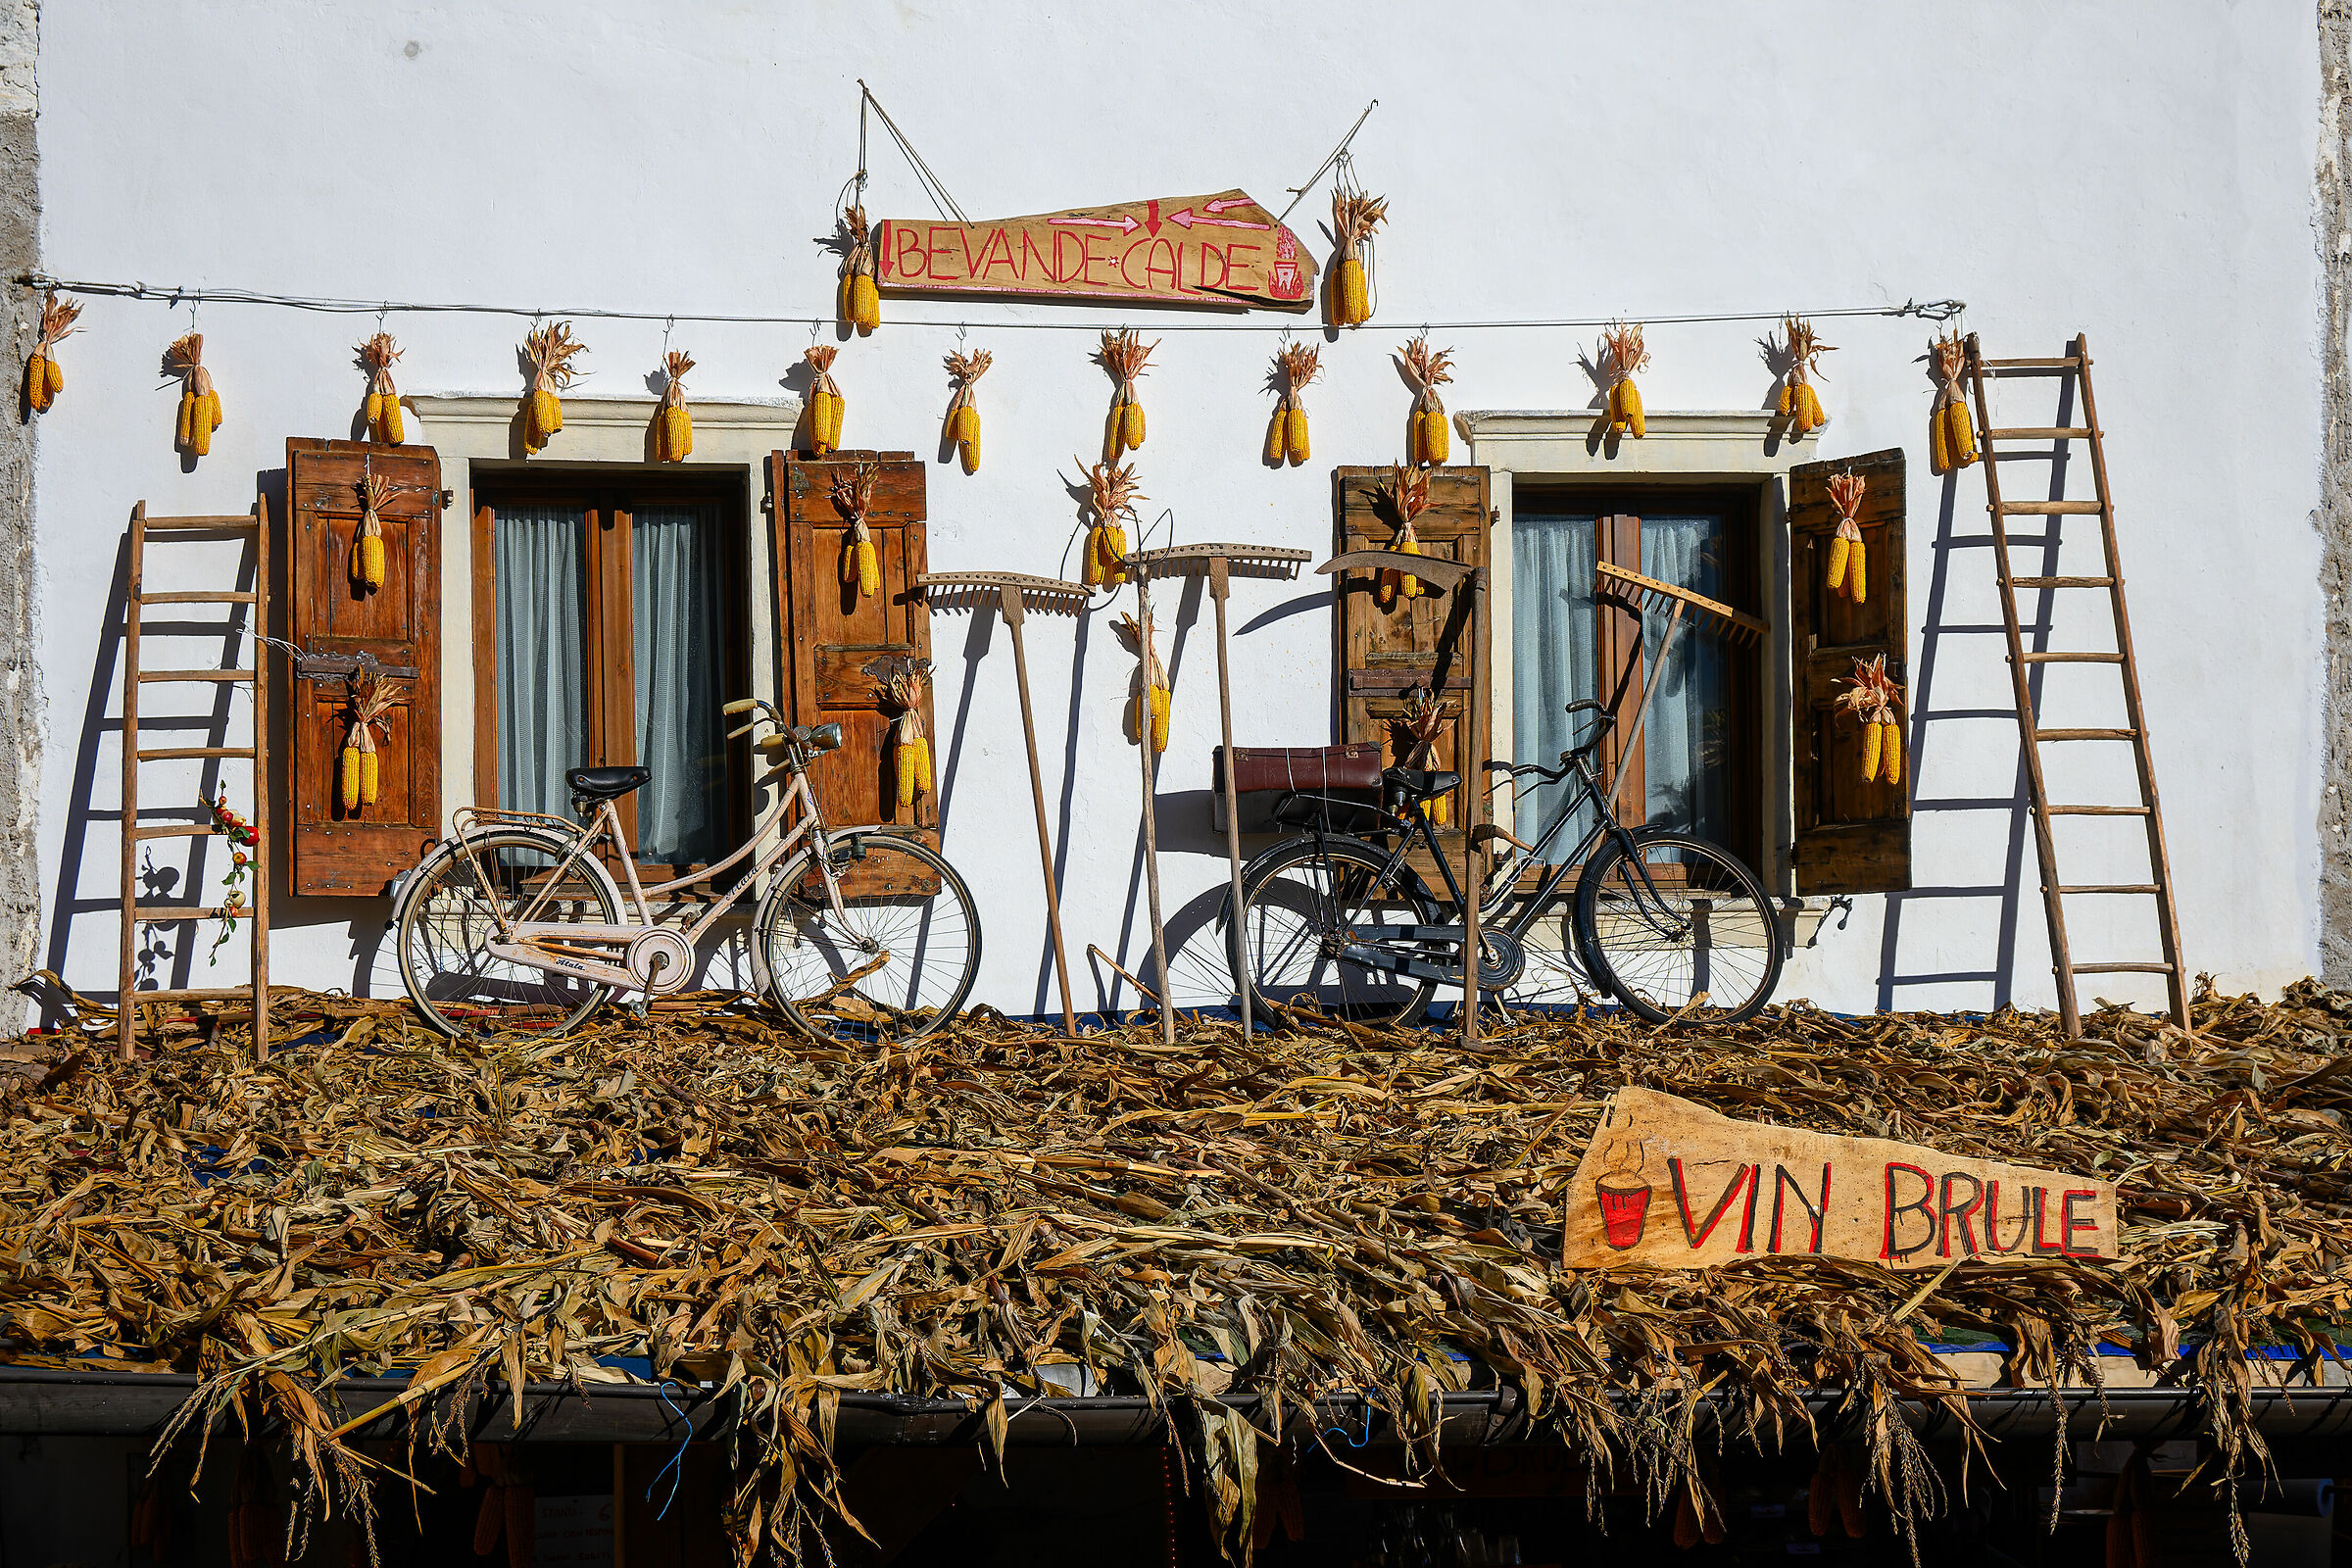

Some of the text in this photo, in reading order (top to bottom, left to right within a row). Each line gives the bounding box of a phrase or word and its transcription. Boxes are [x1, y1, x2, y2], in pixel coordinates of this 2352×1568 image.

[896, 225, 1261, 294] BEVANDE CALDE
[1666, 1157, 2101, 1261] VIN BRULE
